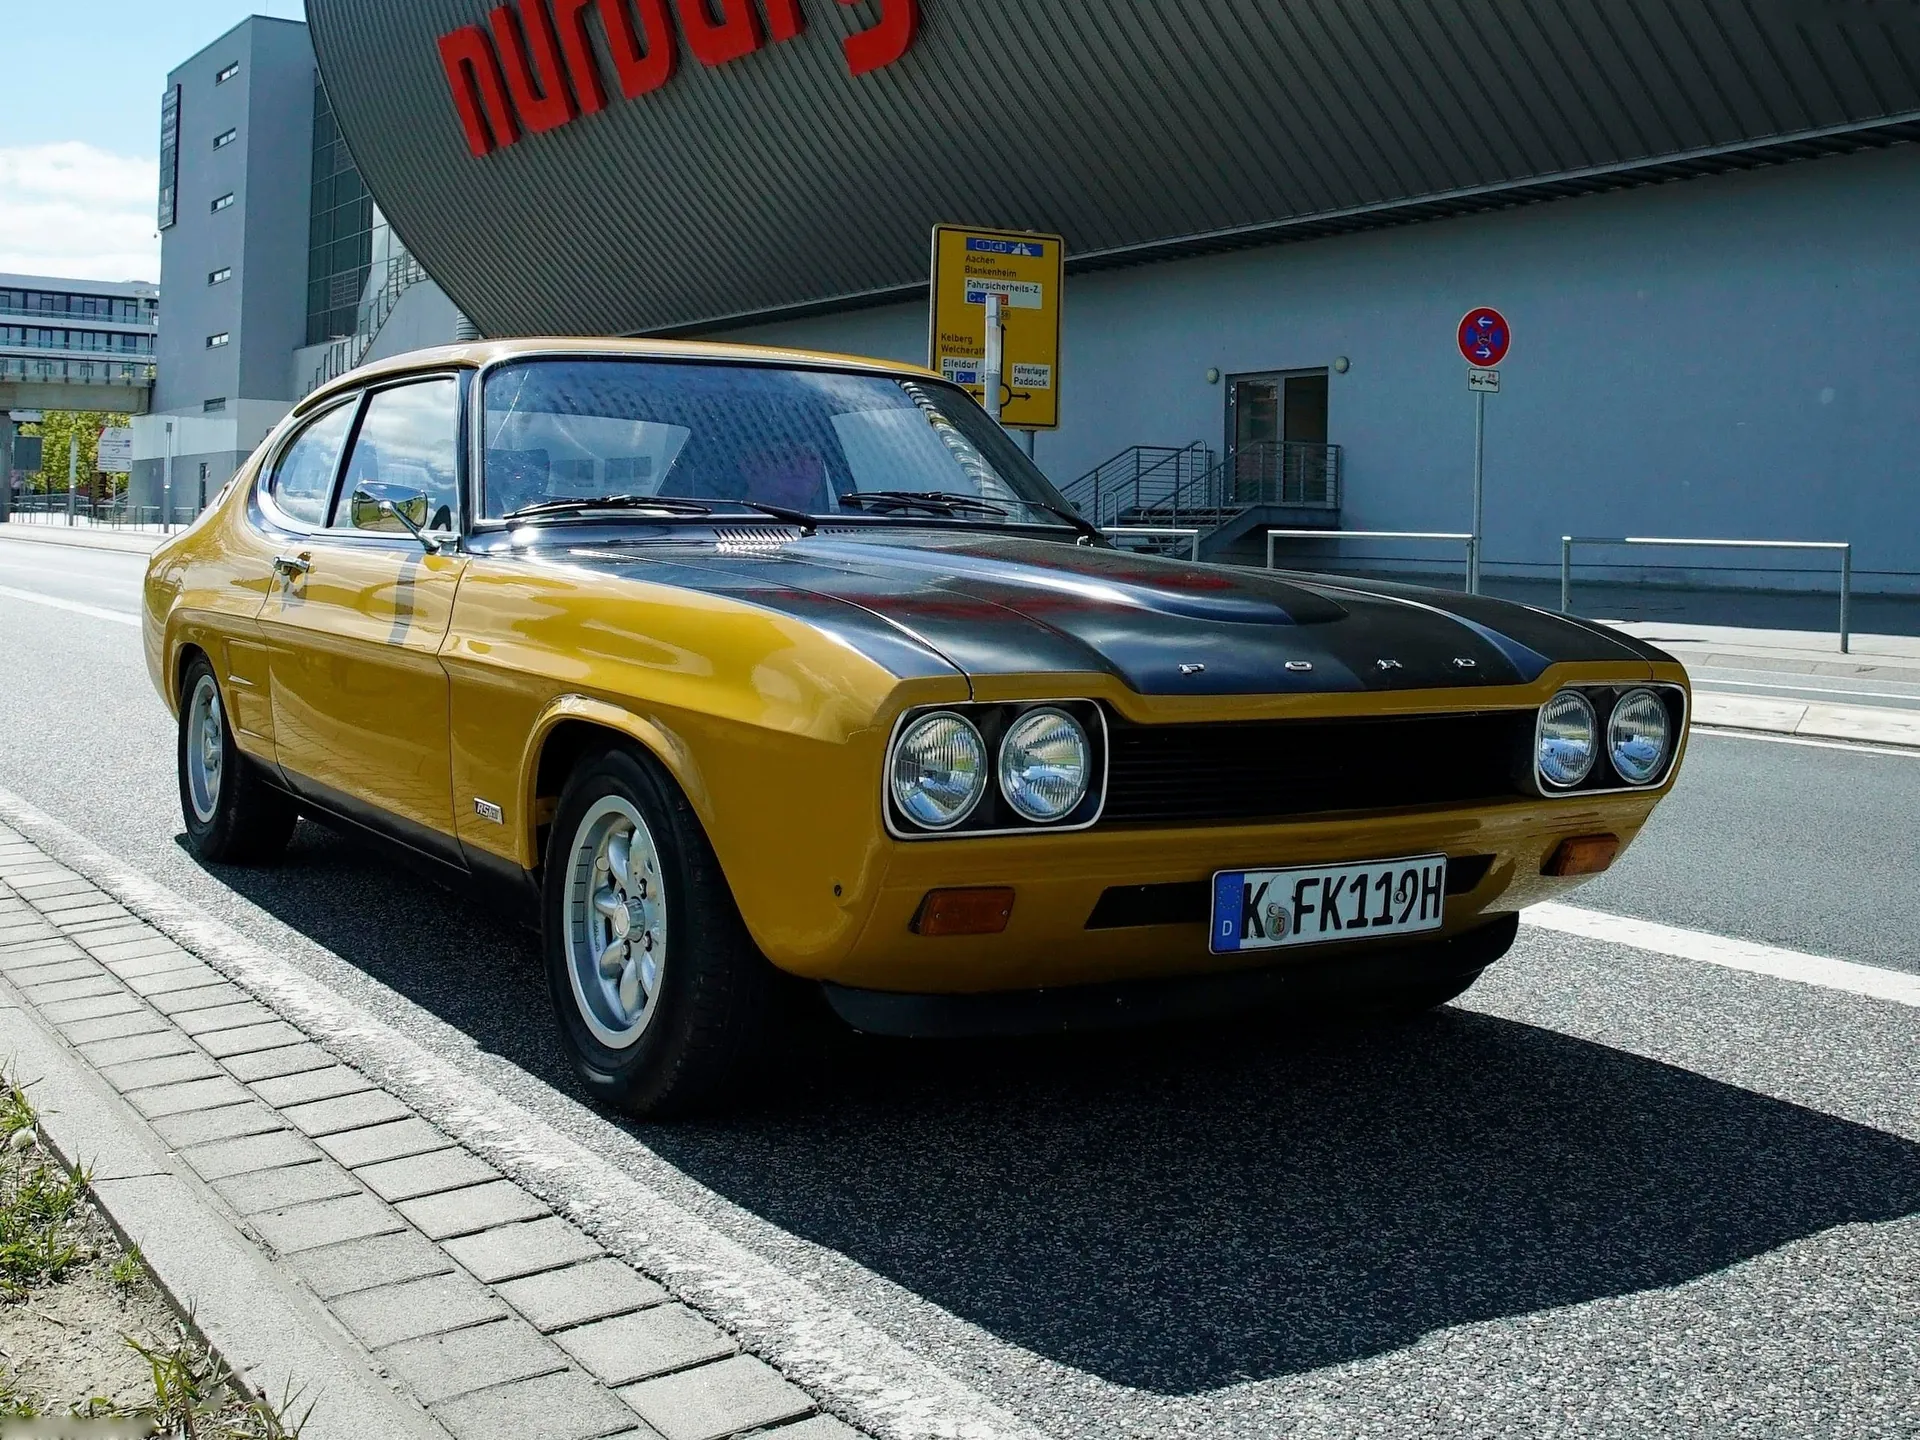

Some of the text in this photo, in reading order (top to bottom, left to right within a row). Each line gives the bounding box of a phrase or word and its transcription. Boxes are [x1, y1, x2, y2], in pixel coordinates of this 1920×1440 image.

[965, 254, 996, 265] Aachen
[964, 265, 1017, 277] Blankenheim
[941, 332, 973, 345] Kelberg
[943, 358, 979, 369] Eifeldorf
[1014, 365, 1049, 377] Fahrerlager
[1014, 376, 1048, 387] Paddock
[1222, 920, 1233, 937] D
